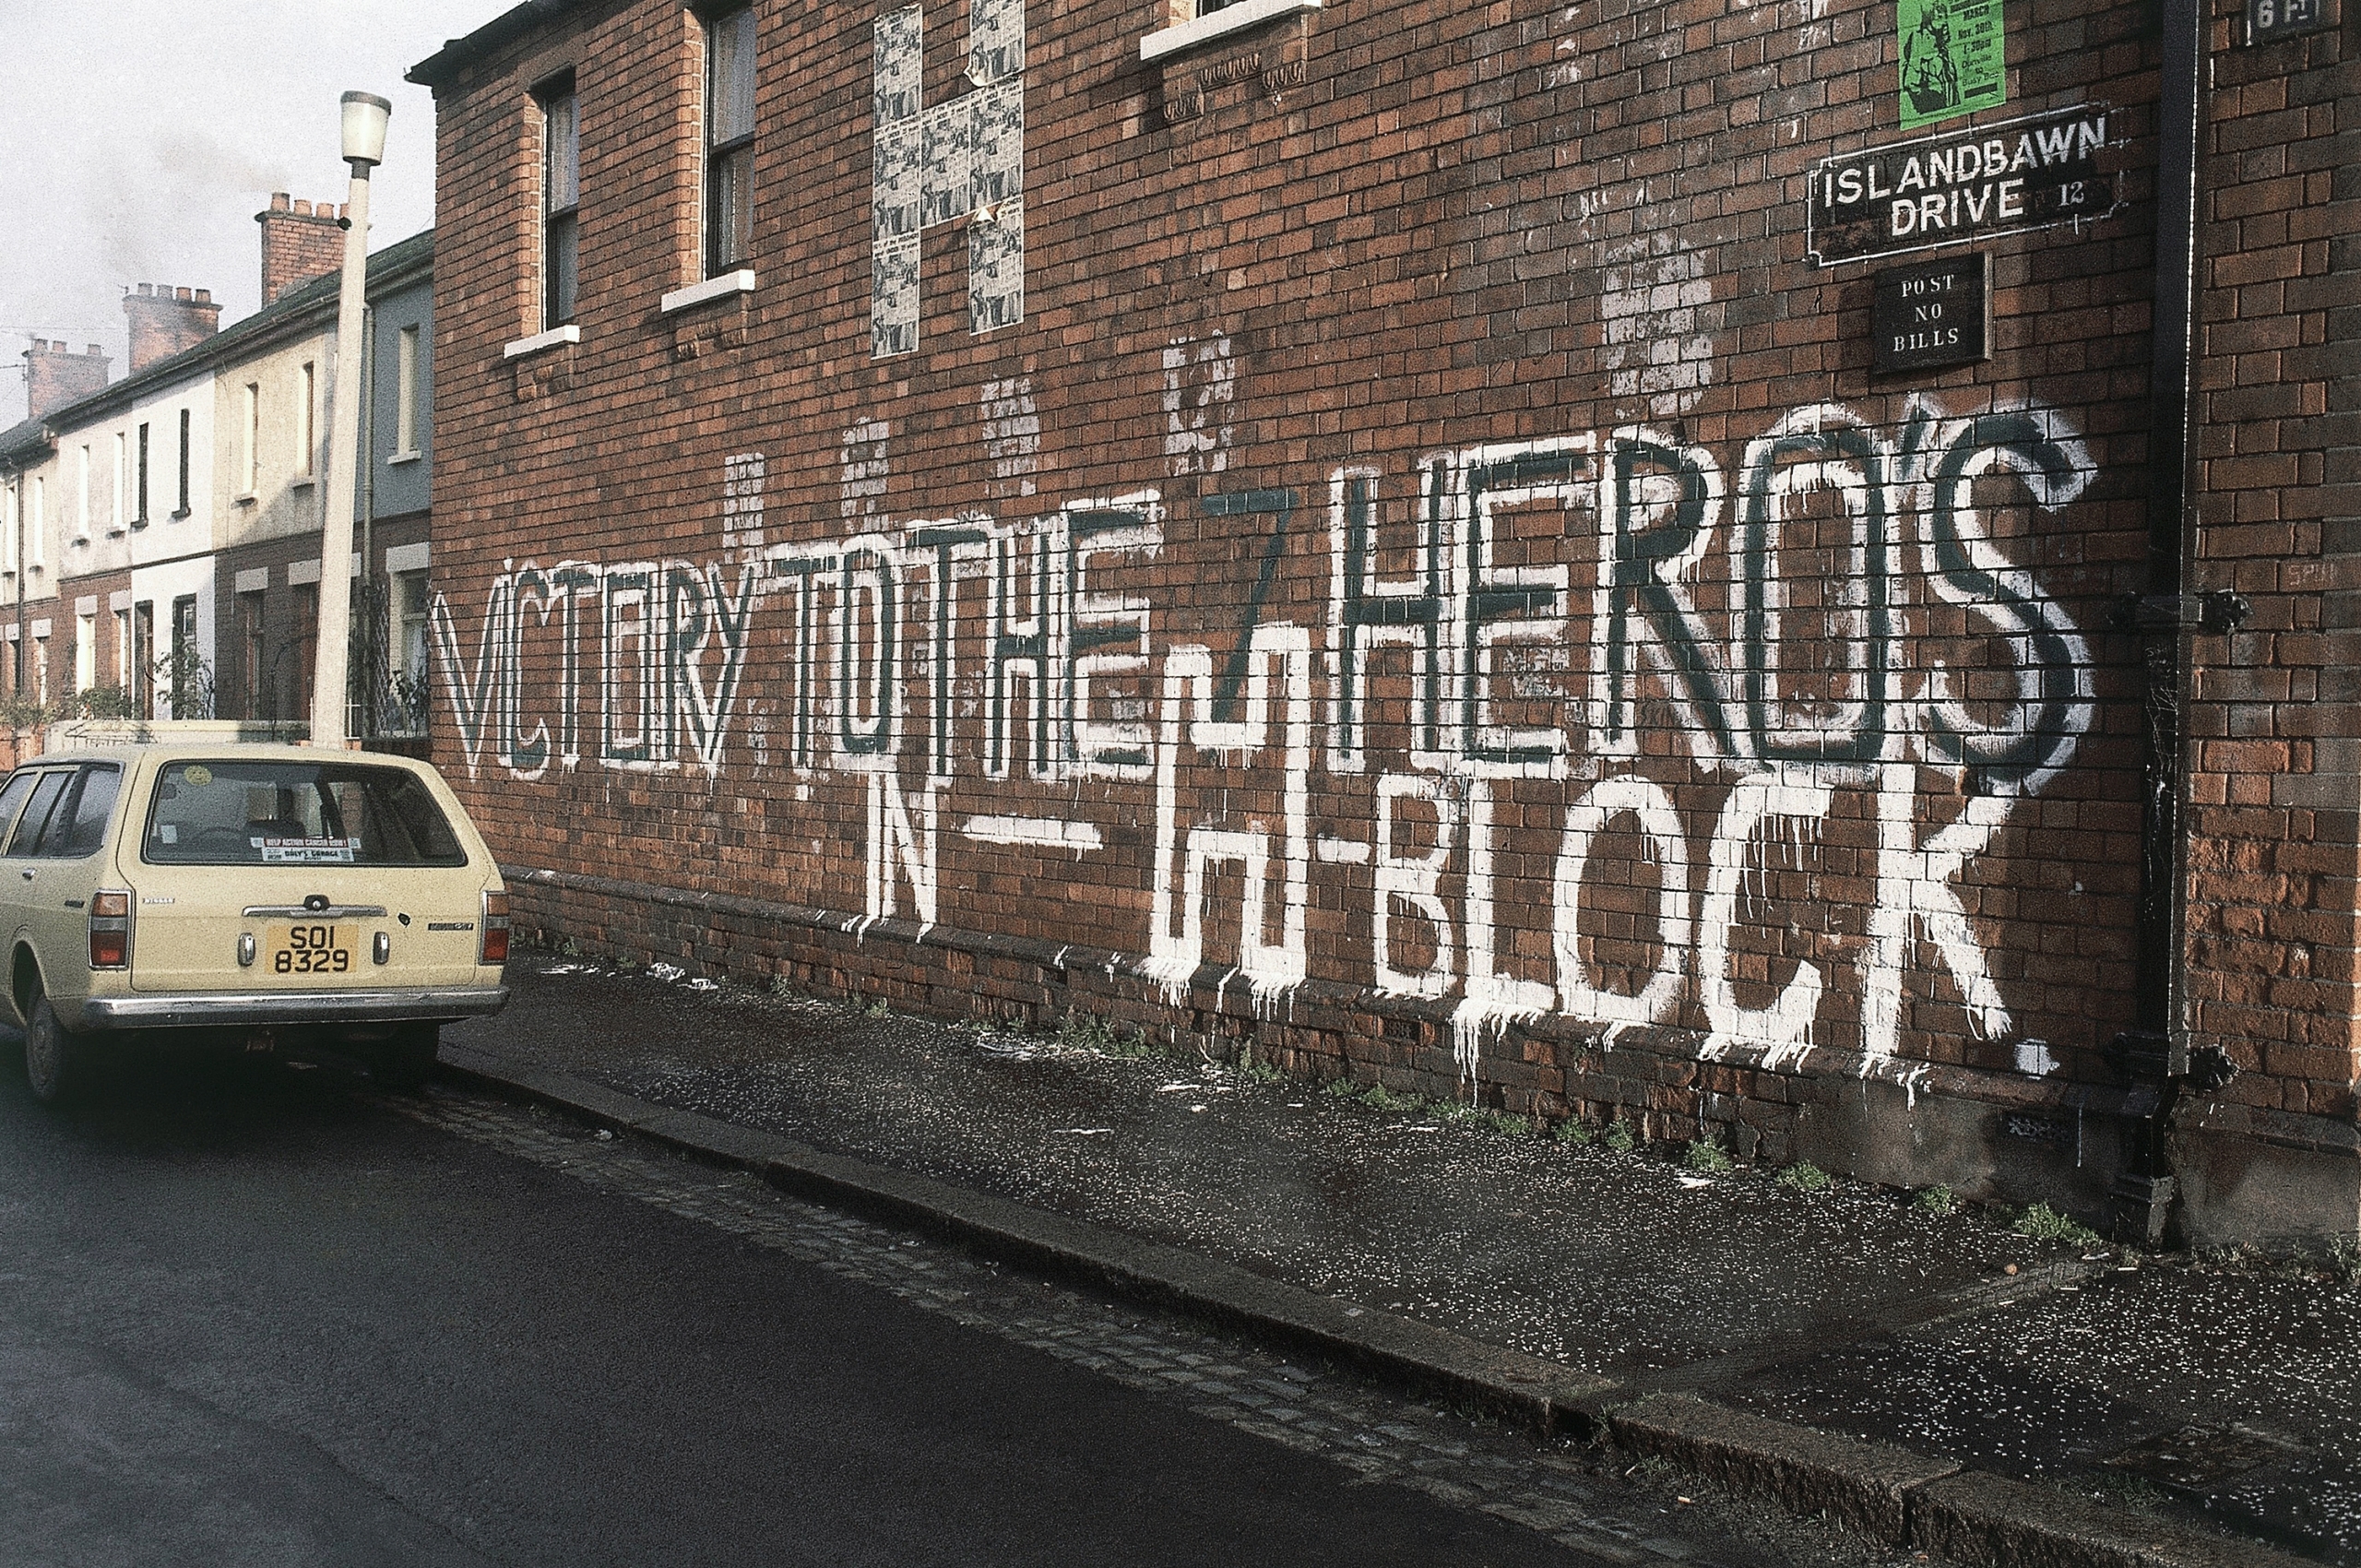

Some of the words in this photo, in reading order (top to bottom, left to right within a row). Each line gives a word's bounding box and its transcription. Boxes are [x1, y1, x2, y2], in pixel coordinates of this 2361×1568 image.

[1963, 5, 1990, 21] MARCH
[1824, 116, 2106, 208] ISLANDBAWN
[1892, 177, 2025, 237] DRIVE
[2058, 180, 2085, 208] 12
[1901, 274, 1954, 297] POST
[1915, 303, 1942, 323] NO
[1892, 327, 1959, 351] BILLS
[432, 556, 762, 780] VICTORY
[762, 533, 905, 777] TO
[904, 489, 1165, 786] THE
[275, 949, 349, 973] 8329
